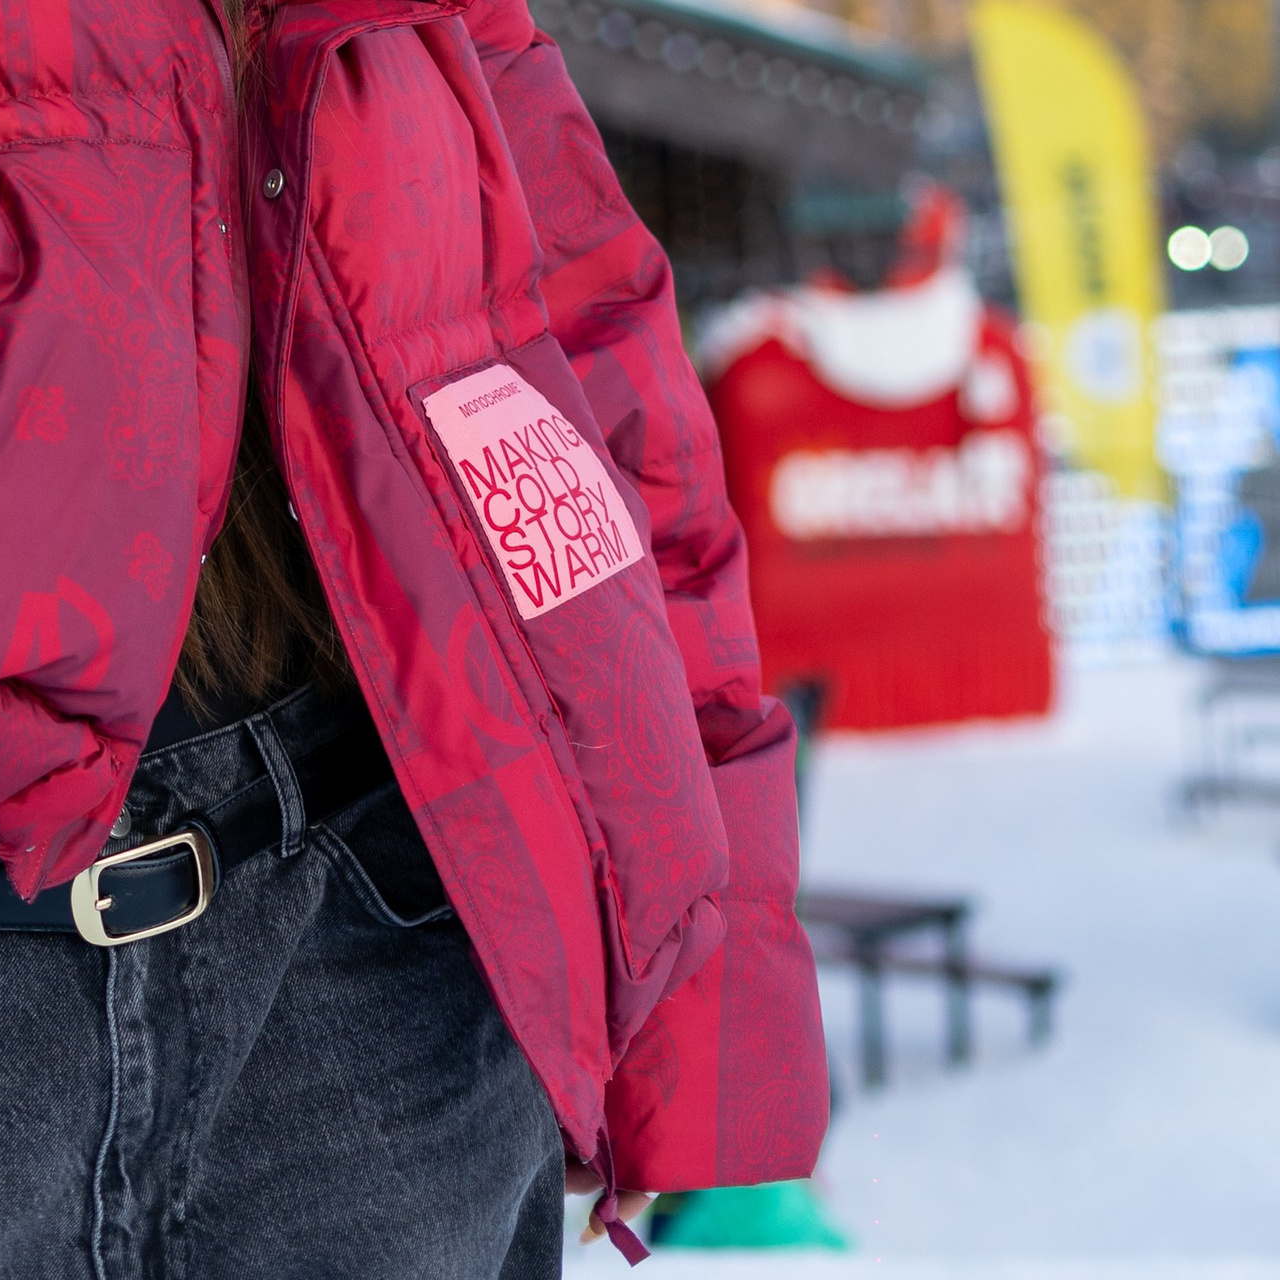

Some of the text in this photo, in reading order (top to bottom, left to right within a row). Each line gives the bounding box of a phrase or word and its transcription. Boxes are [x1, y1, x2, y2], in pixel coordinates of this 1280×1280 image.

[458, 381, 522, 419] MONOCHROME
[459, 414, 582, 500] MAKING
[483, 455, 582, 533] COLD
[500, 481, 610, 570] STORY
[512, 520, 629, 608] WARM
